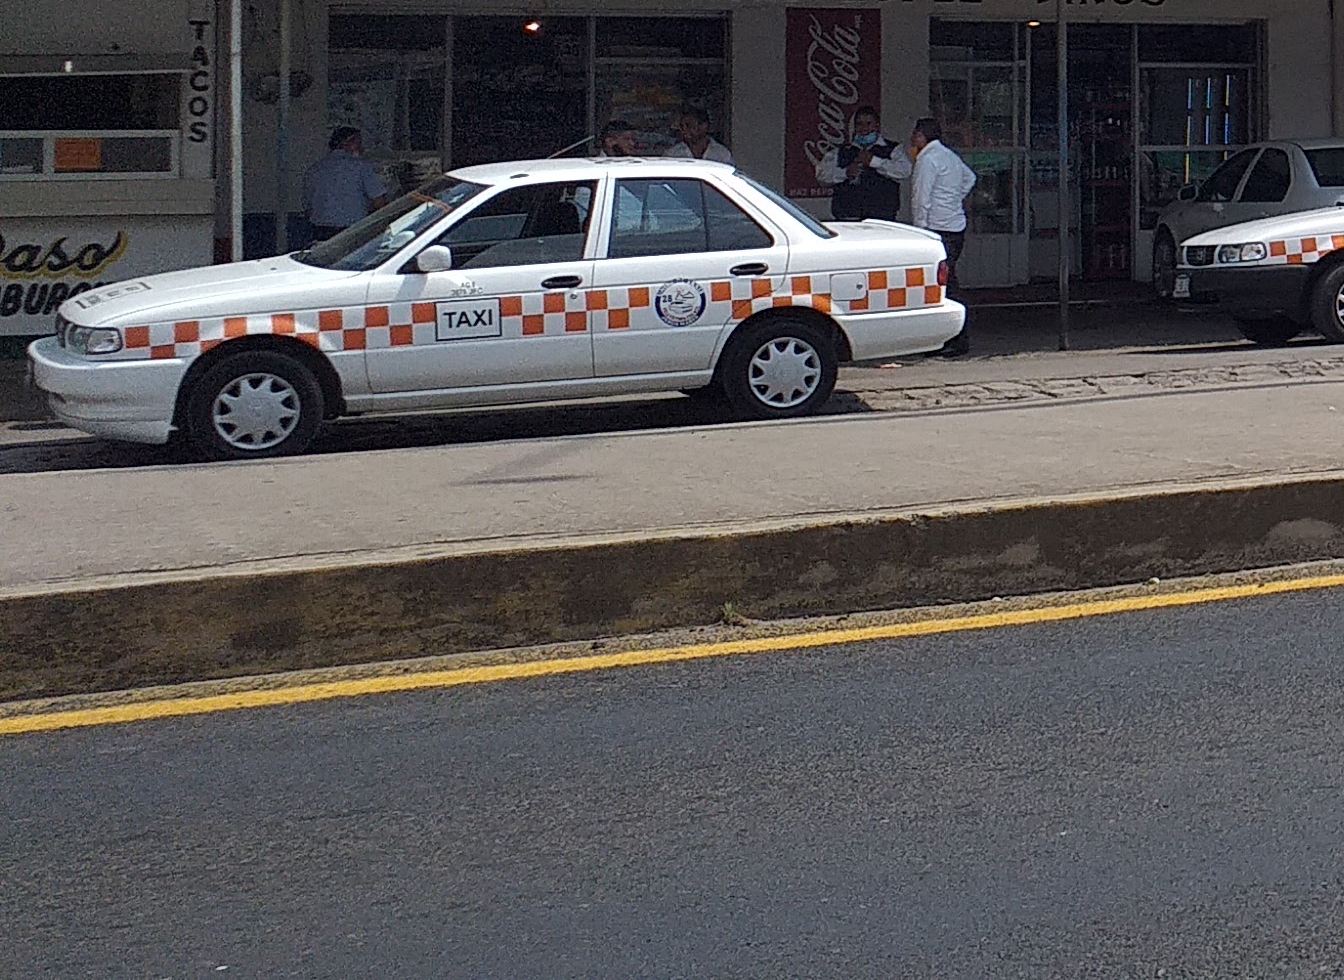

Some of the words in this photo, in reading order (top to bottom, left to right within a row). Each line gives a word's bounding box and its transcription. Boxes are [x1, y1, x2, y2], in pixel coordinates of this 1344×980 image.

[189, 20, 211, 143] TACOS
[0, 231, 125, 274] aso
[443, 308, 493, 329] TAXI
